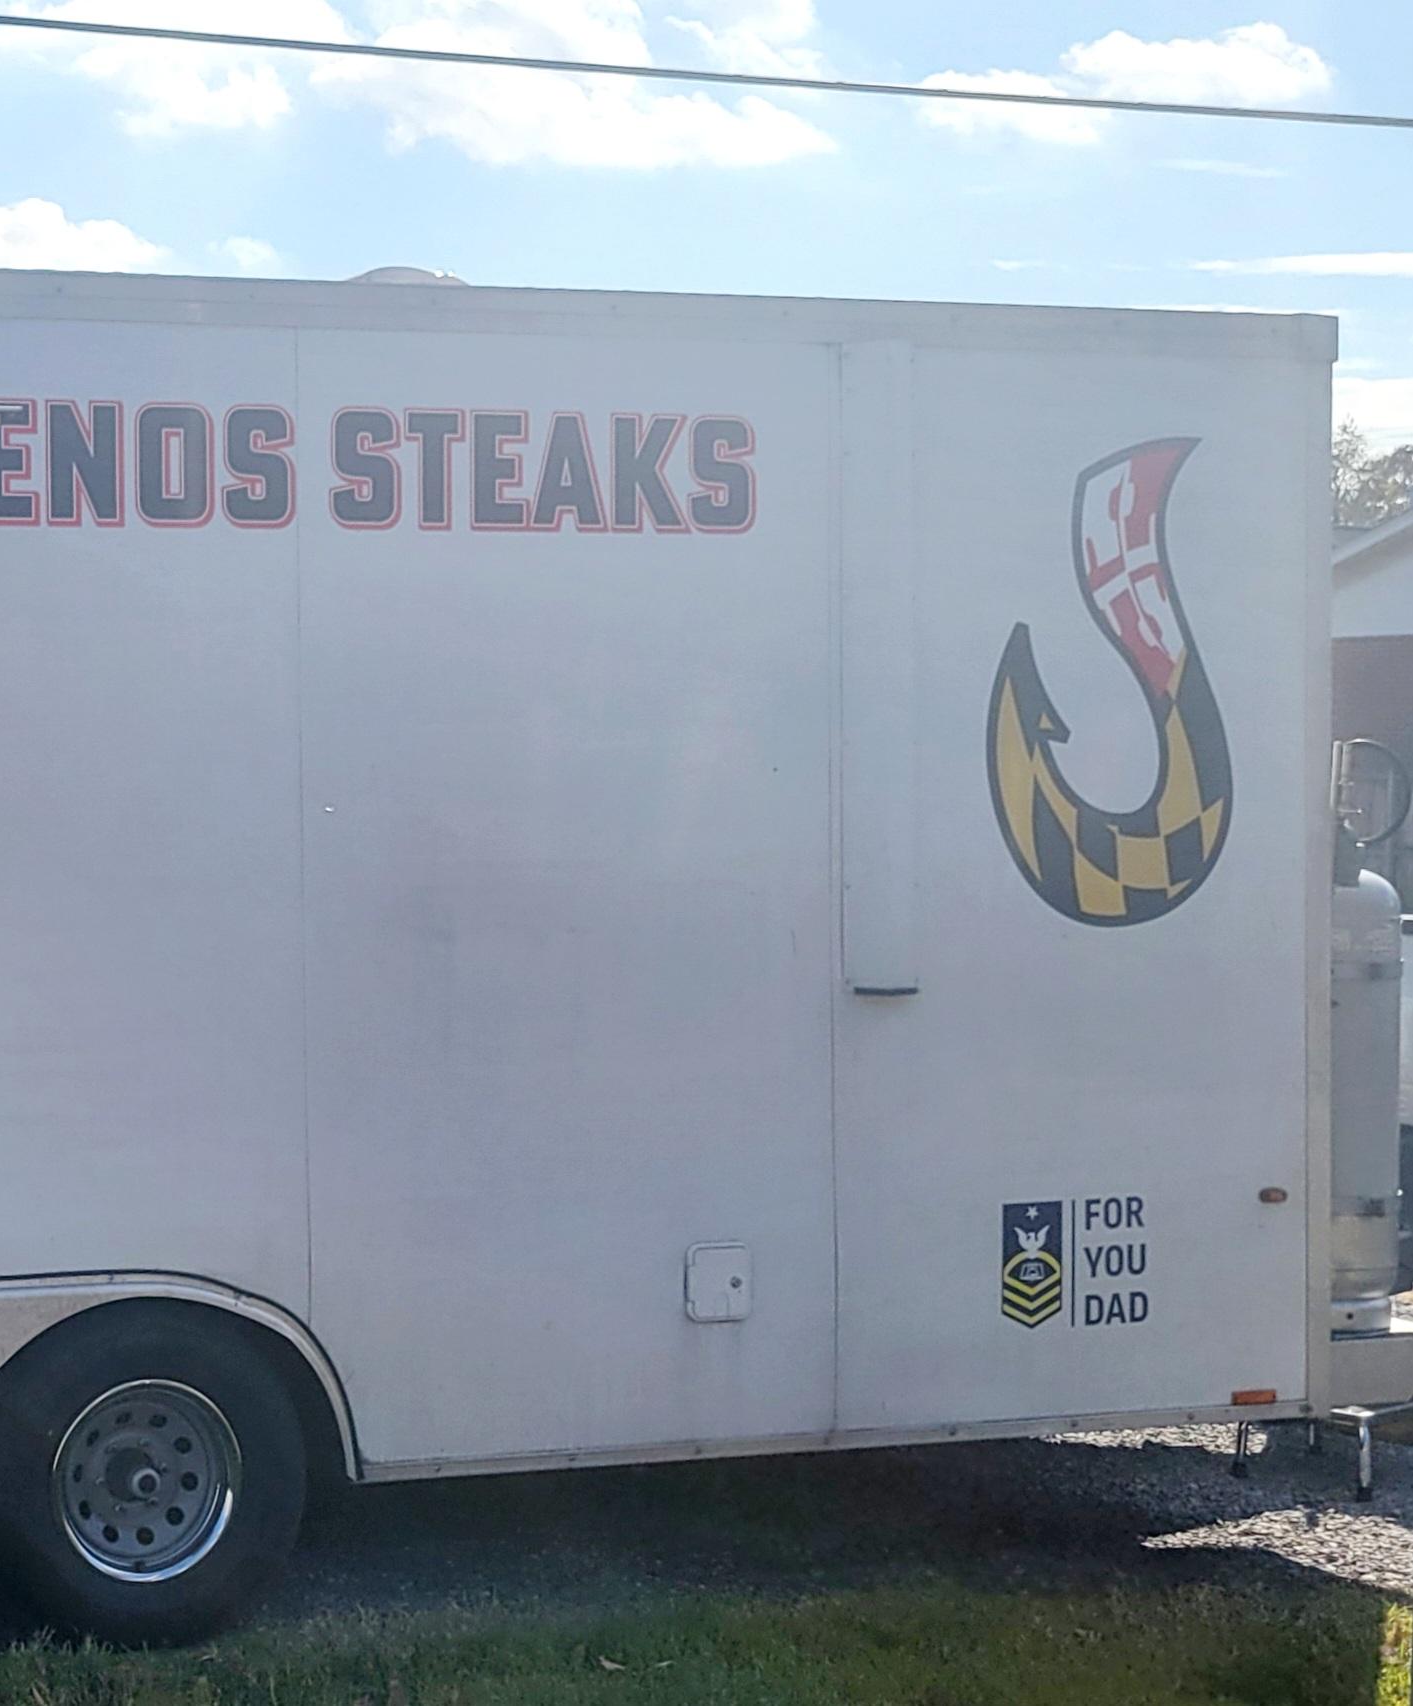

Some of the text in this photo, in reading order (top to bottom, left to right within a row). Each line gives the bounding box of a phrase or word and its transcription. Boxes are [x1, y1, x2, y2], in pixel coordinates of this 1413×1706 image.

[329, 406, 758, 535] STEAKS
[1085, 1196, 1145, 1231] FOR
[1083, 1243, 1147, 1278] YOU
[1085, 1291, 1149, 1326] DAD
